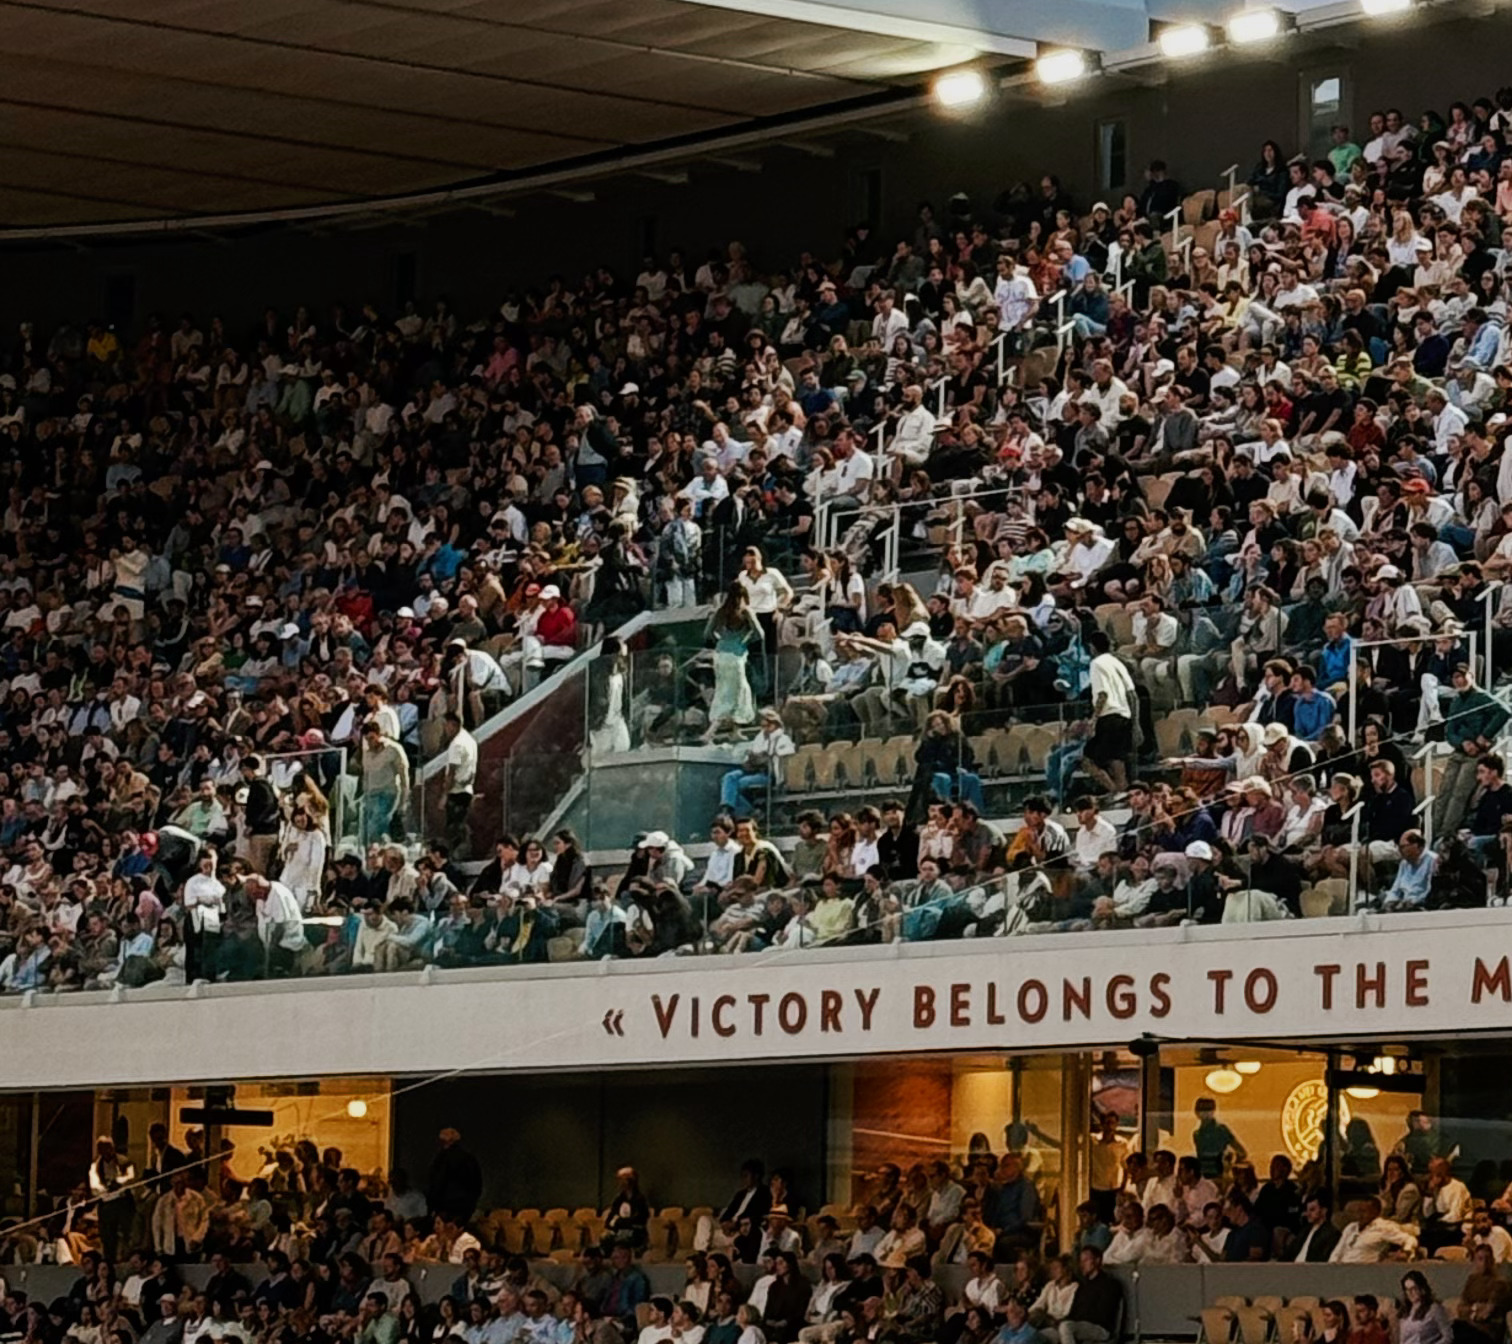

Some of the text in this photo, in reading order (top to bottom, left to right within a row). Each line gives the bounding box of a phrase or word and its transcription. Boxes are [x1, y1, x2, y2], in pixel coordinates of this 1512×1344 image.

[650, 987, 881, 1039] VICTORY
[912, 972, 1172, 1030] BELONGS
[1207, 967, 1279, 1015] TO
[1313, 958, 1430, 1011] THE
